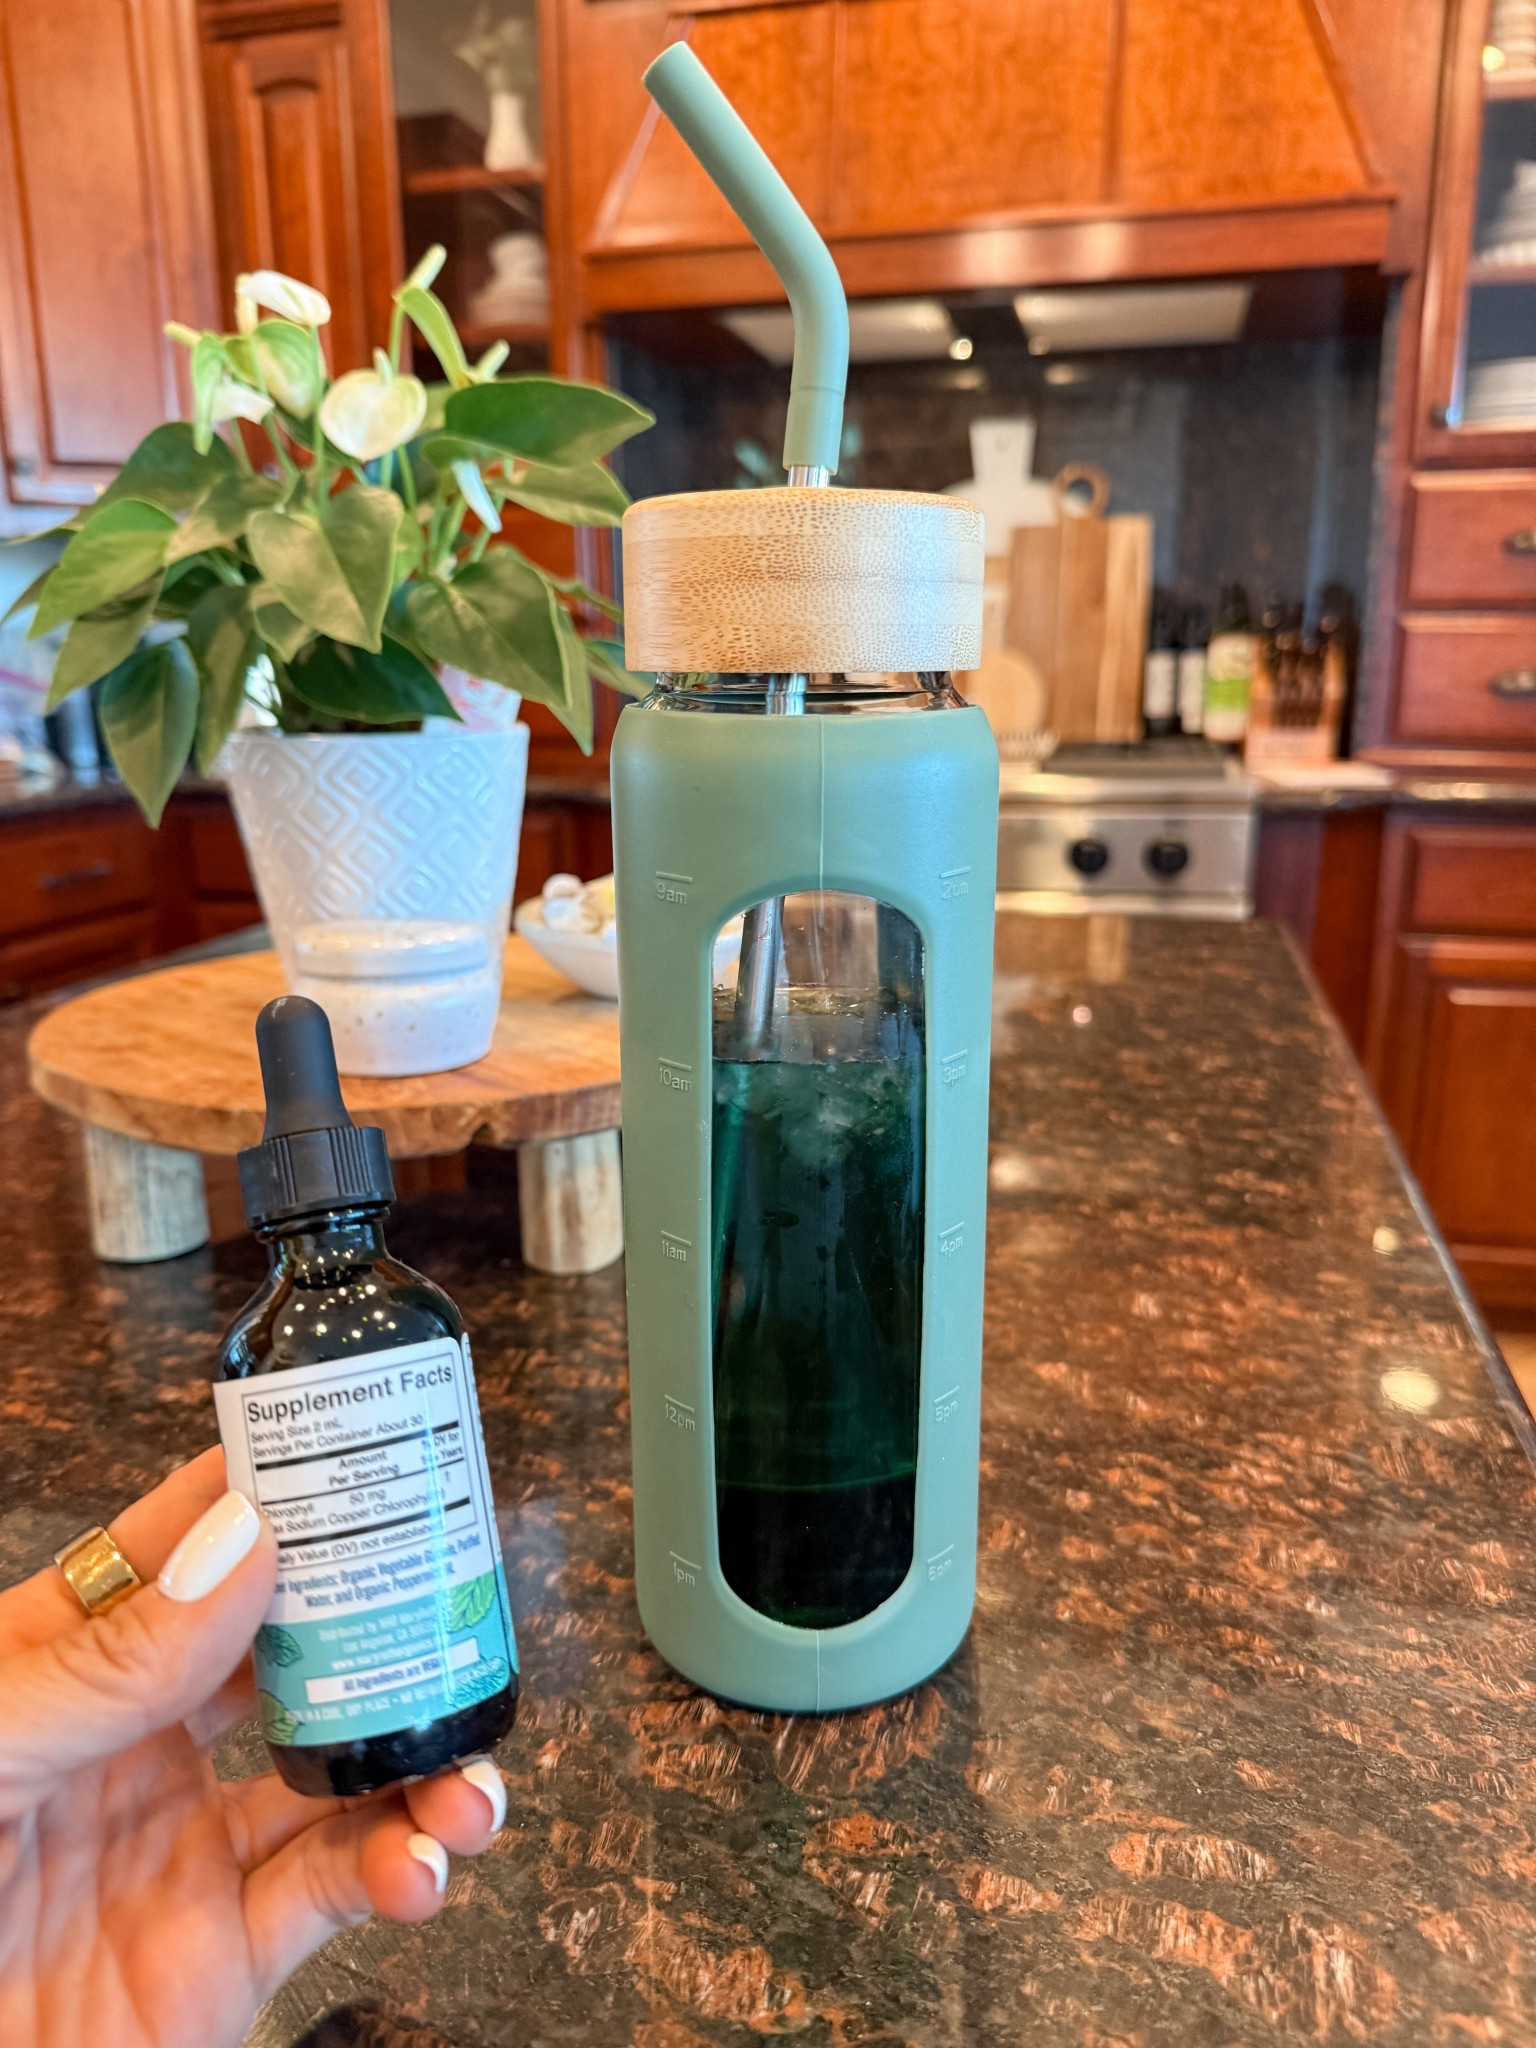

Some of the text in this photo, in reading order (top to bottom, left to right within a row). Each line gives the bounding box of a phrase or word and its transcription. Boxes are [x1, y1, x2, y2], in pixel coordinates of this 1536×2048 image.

[655, 882, 688, 905] 9am
[940, 880, 970, 900] 2pm
[658, 1068, 693, 1092] 10am
[941, 1063, 967, 1087] 3pm
[661, 1240, 688, 1262] 11am
[939, 1234, 964, 1259] 4pm
[247, 1364, 453, 1424] Supplement Facts
[664, 1404, 697, 1432] 12pm
[934, 1399, 959, 1424] 5pm
[250, 1429, 285, 1444] Serving
[286, 1424, 311, 1437] Size
[312, 1421, 322, 1433] 2
[252, 1413, 424, 1459] Servings Per Container About 30
[338, 1450, 388, 1470] Amount
[328, 1463, 400, 1487] Per Serving
[285, 1518, 328, 1533] Sodium
[327, 1507, 371, 1526] Copper
[297, 1549, 330, 1562] Value
[331, 1541, 359, 1559] (DV)
[360, 1537, 380, 1550] not
[672, 1562, 697, 1587] 1pm
[927, 1557, 953, 1583] 6pm
